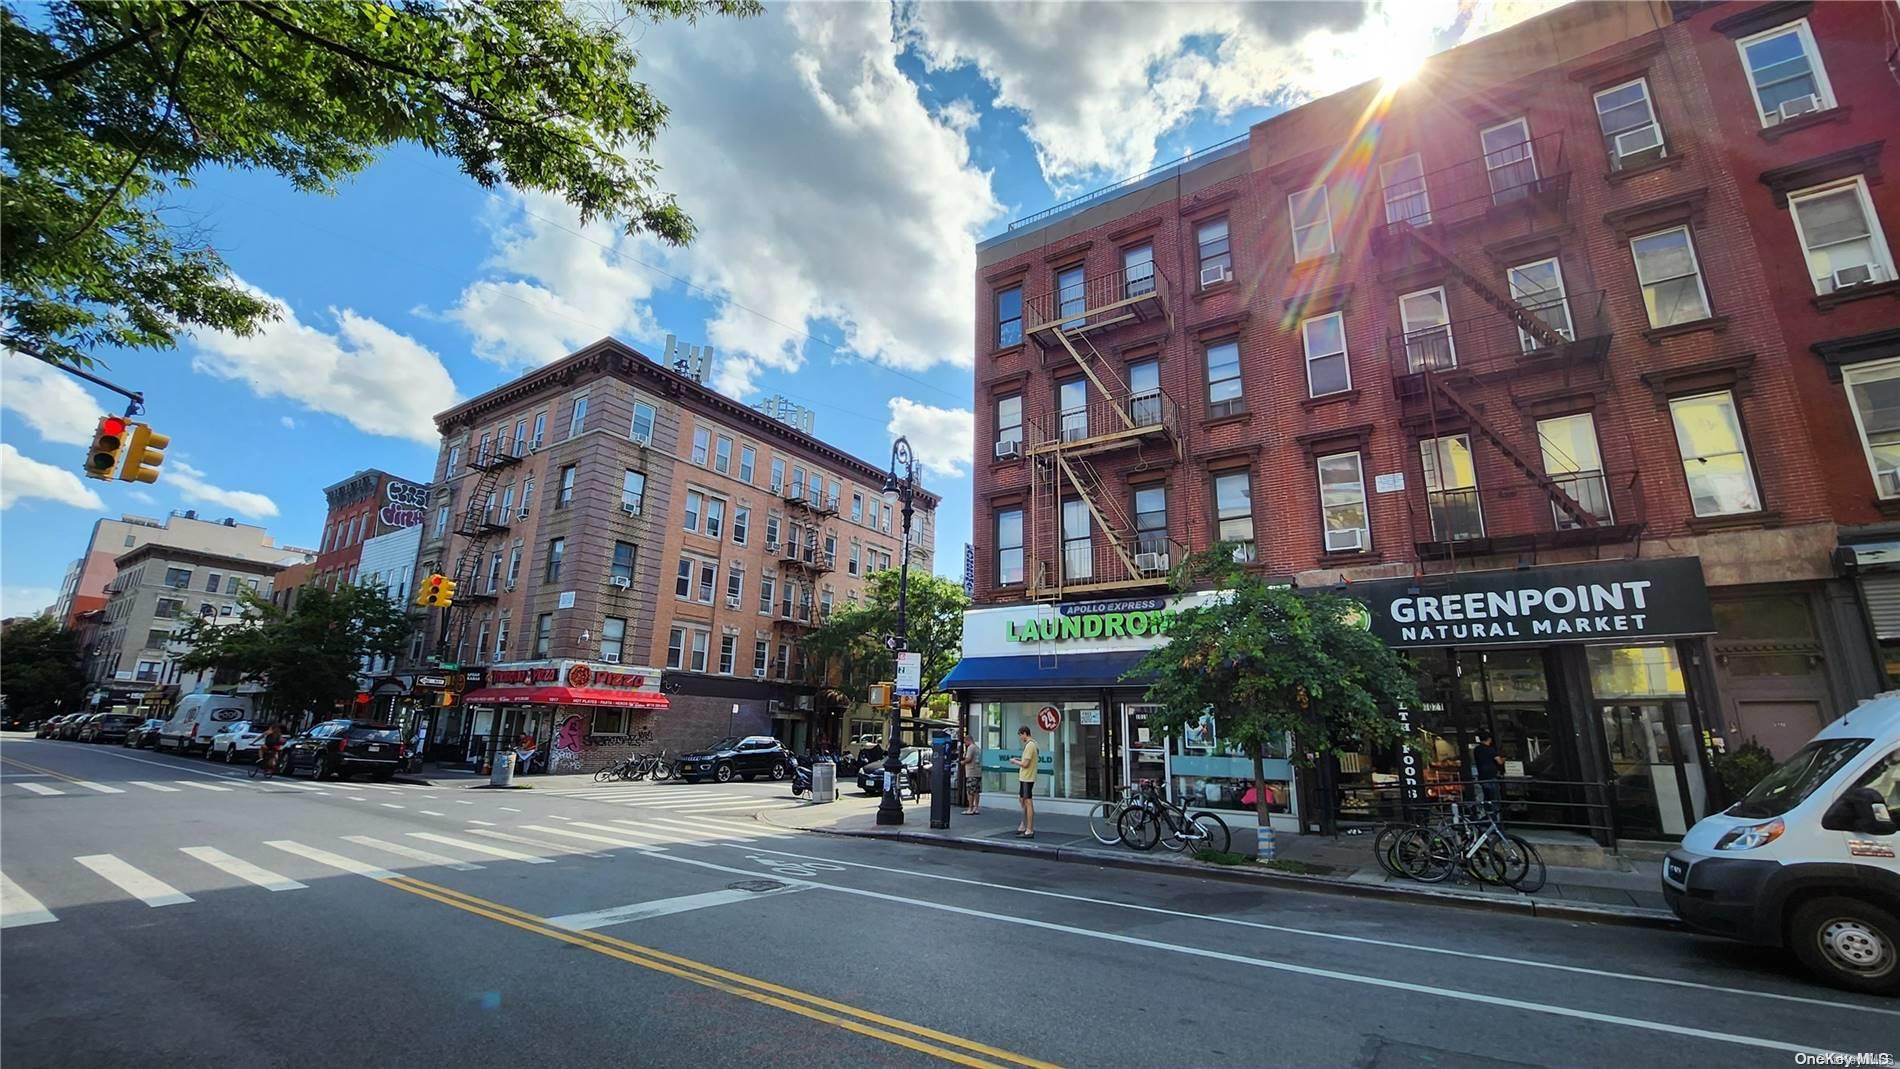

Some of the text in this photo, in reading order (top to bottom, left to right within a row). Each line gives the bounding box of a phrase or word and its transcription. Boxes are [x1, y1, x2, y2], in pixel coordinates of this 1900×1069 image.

[1066, 600, 1156, 615] APOLLO EXPRESS
[1390, 580, 1651, 623] GREENPOINT
[1006, 609, 1178, 642] LAUNDROM
[1402, 614, 1646, 641] NATURAL MARKET
